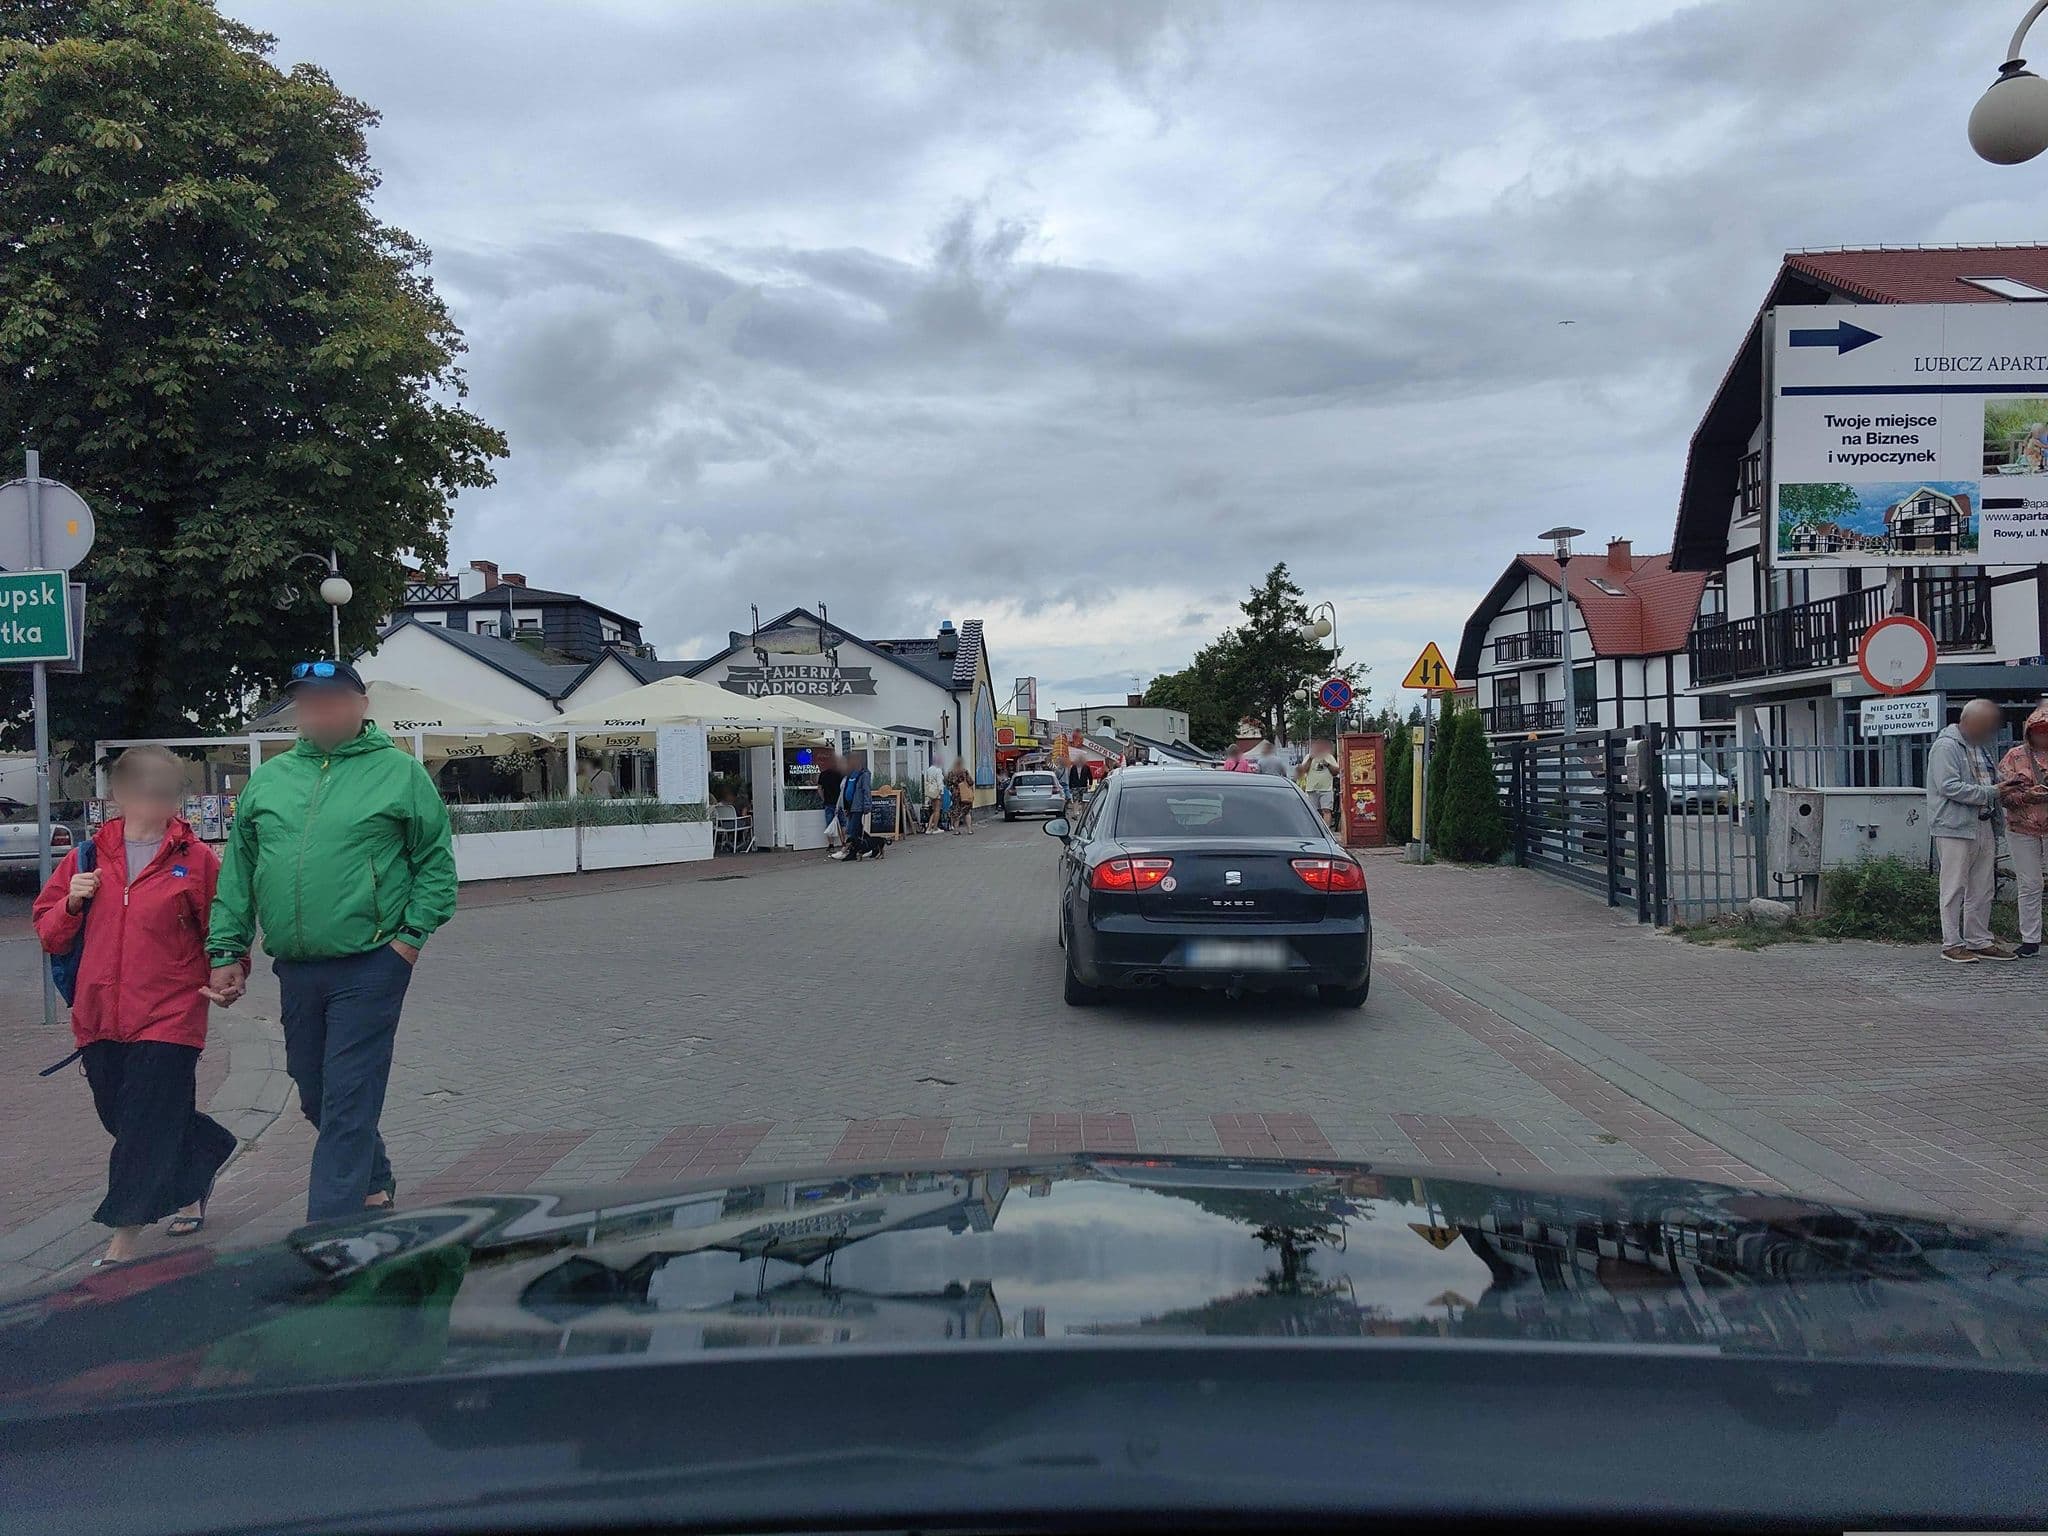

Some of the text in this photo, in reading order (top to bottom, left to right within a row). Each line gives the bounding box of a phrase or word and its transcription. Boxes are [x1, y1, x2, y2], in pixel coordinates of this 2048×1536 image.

[1914, 357, 1983, 372] LUBICZ
[1824, 414, 1937, 430] Twoje miejsce
[1842, 432, 1919, 445] na Biznes
[1828, 449, 1936, 465] i wypoczynek
[1994, 529, 2024, 539] Rowy,
[2026, 529, 2038, 537] ul.
[760, 666, 842, 679] TAWERNA
[747, 681, 852, 695] NADMORSKA
[1887, 702, 1928, 711] DOTYCZY
[393, 720, 442, 731] Kozel
